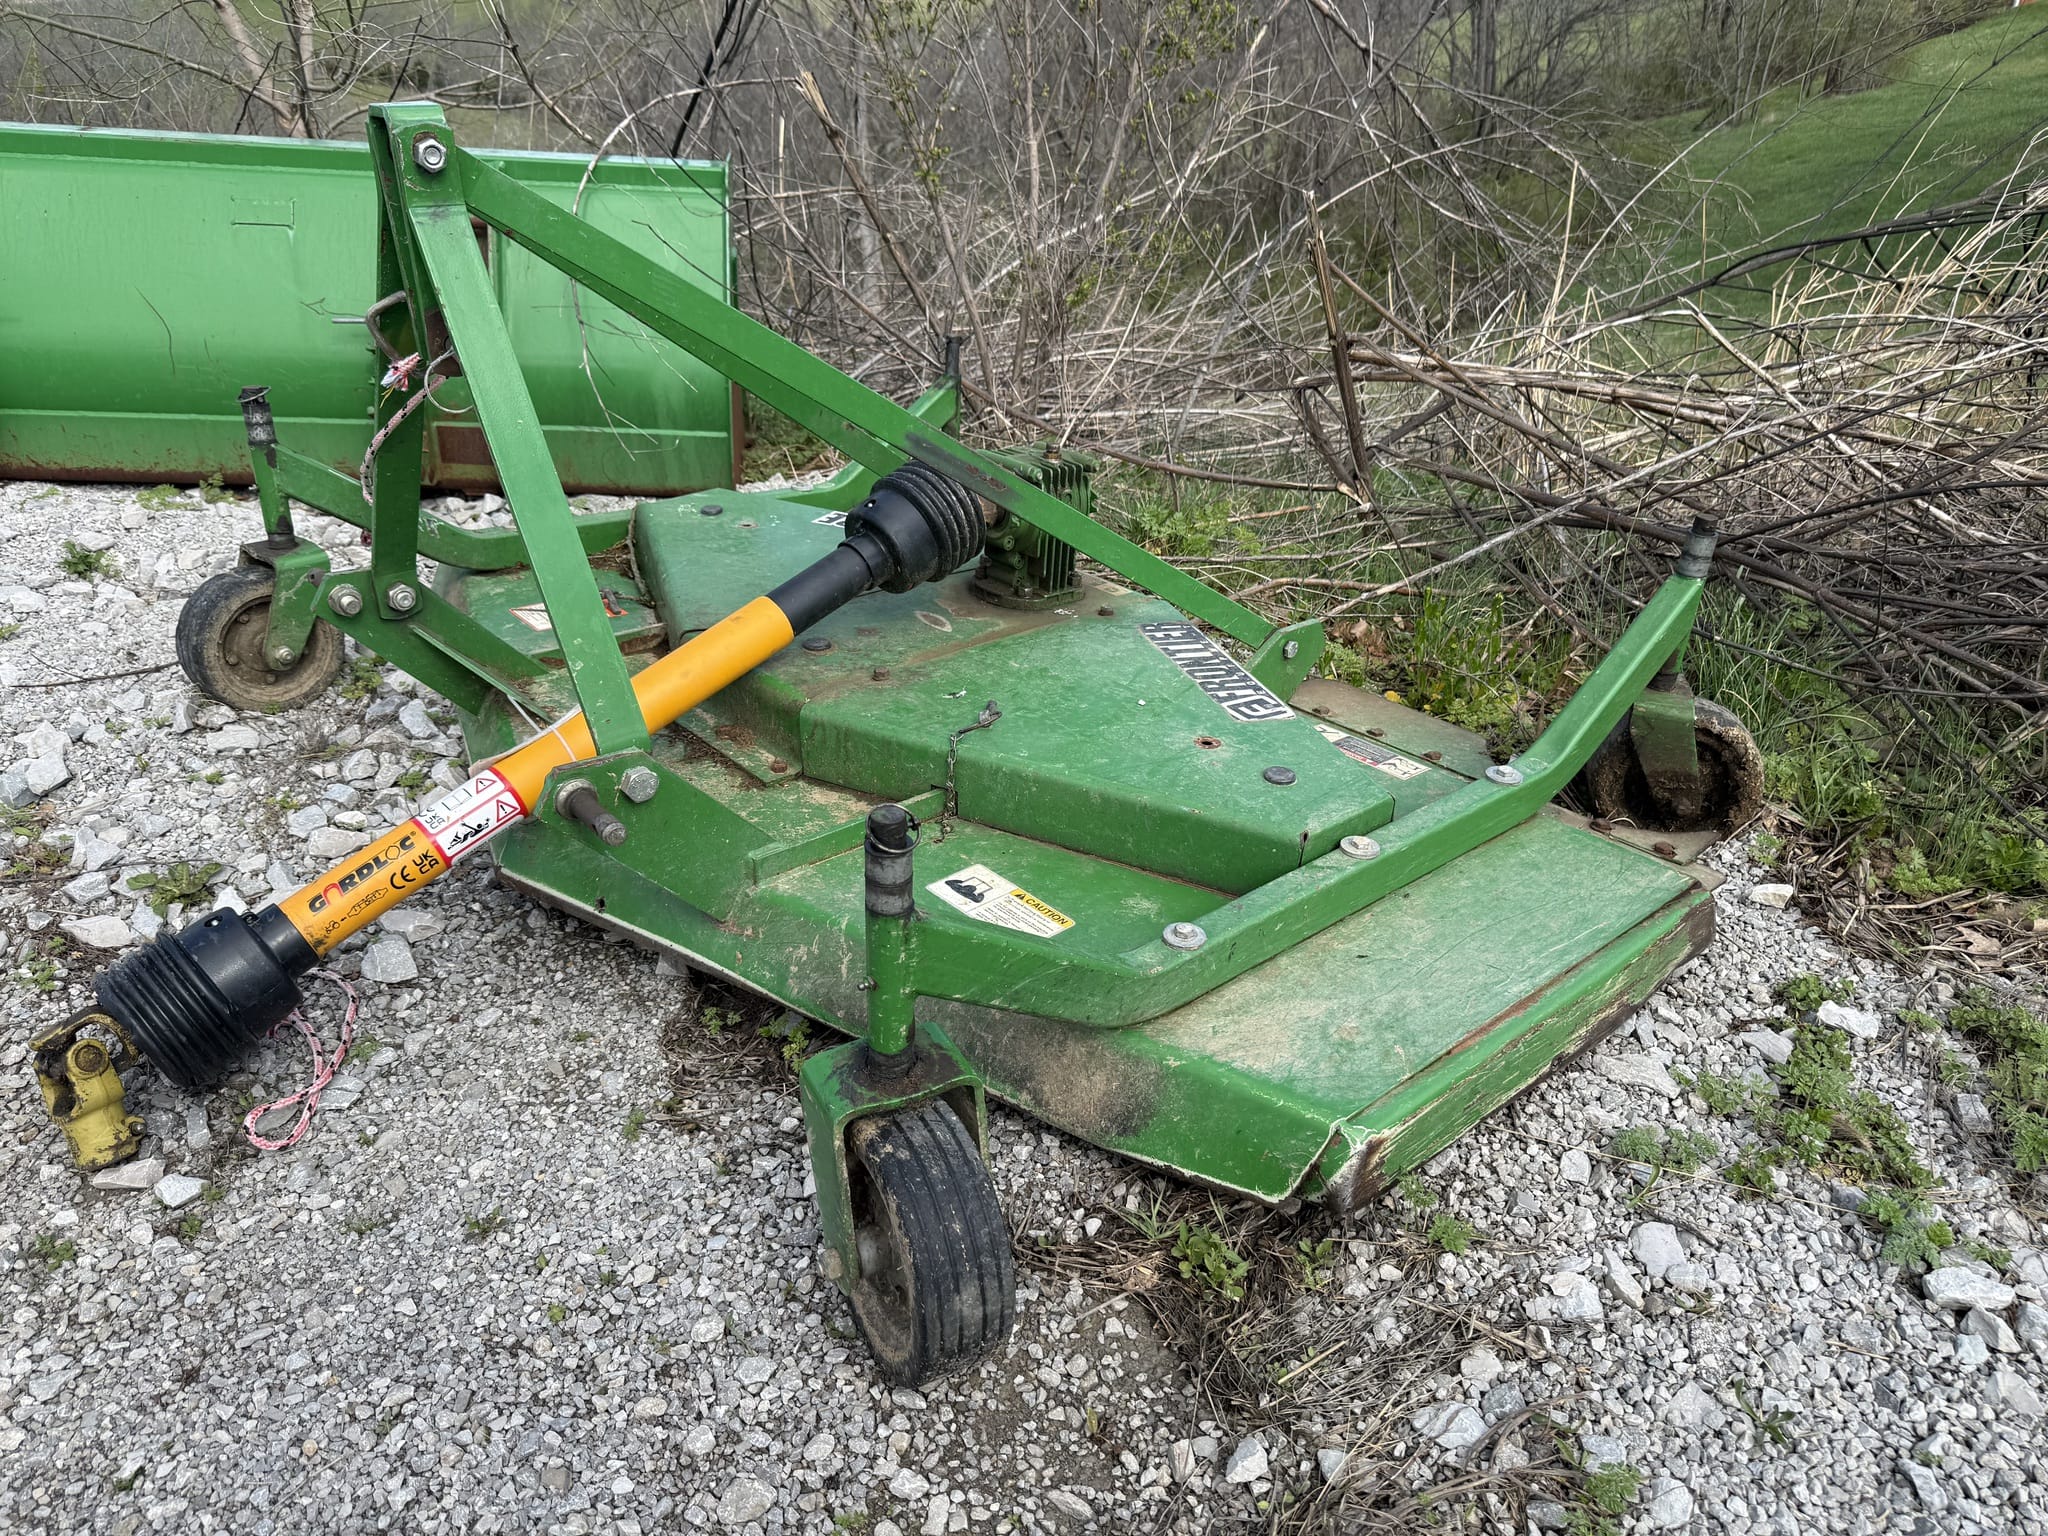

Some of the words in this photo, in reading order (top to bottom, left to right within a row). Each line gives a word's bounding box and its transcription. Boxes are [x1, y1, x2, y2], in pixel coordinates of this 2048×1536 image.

[412, 849, 435, 867] UK
[390, 865, 417, 890] CE
[1025, 897, 1070, 925] CAUTION
